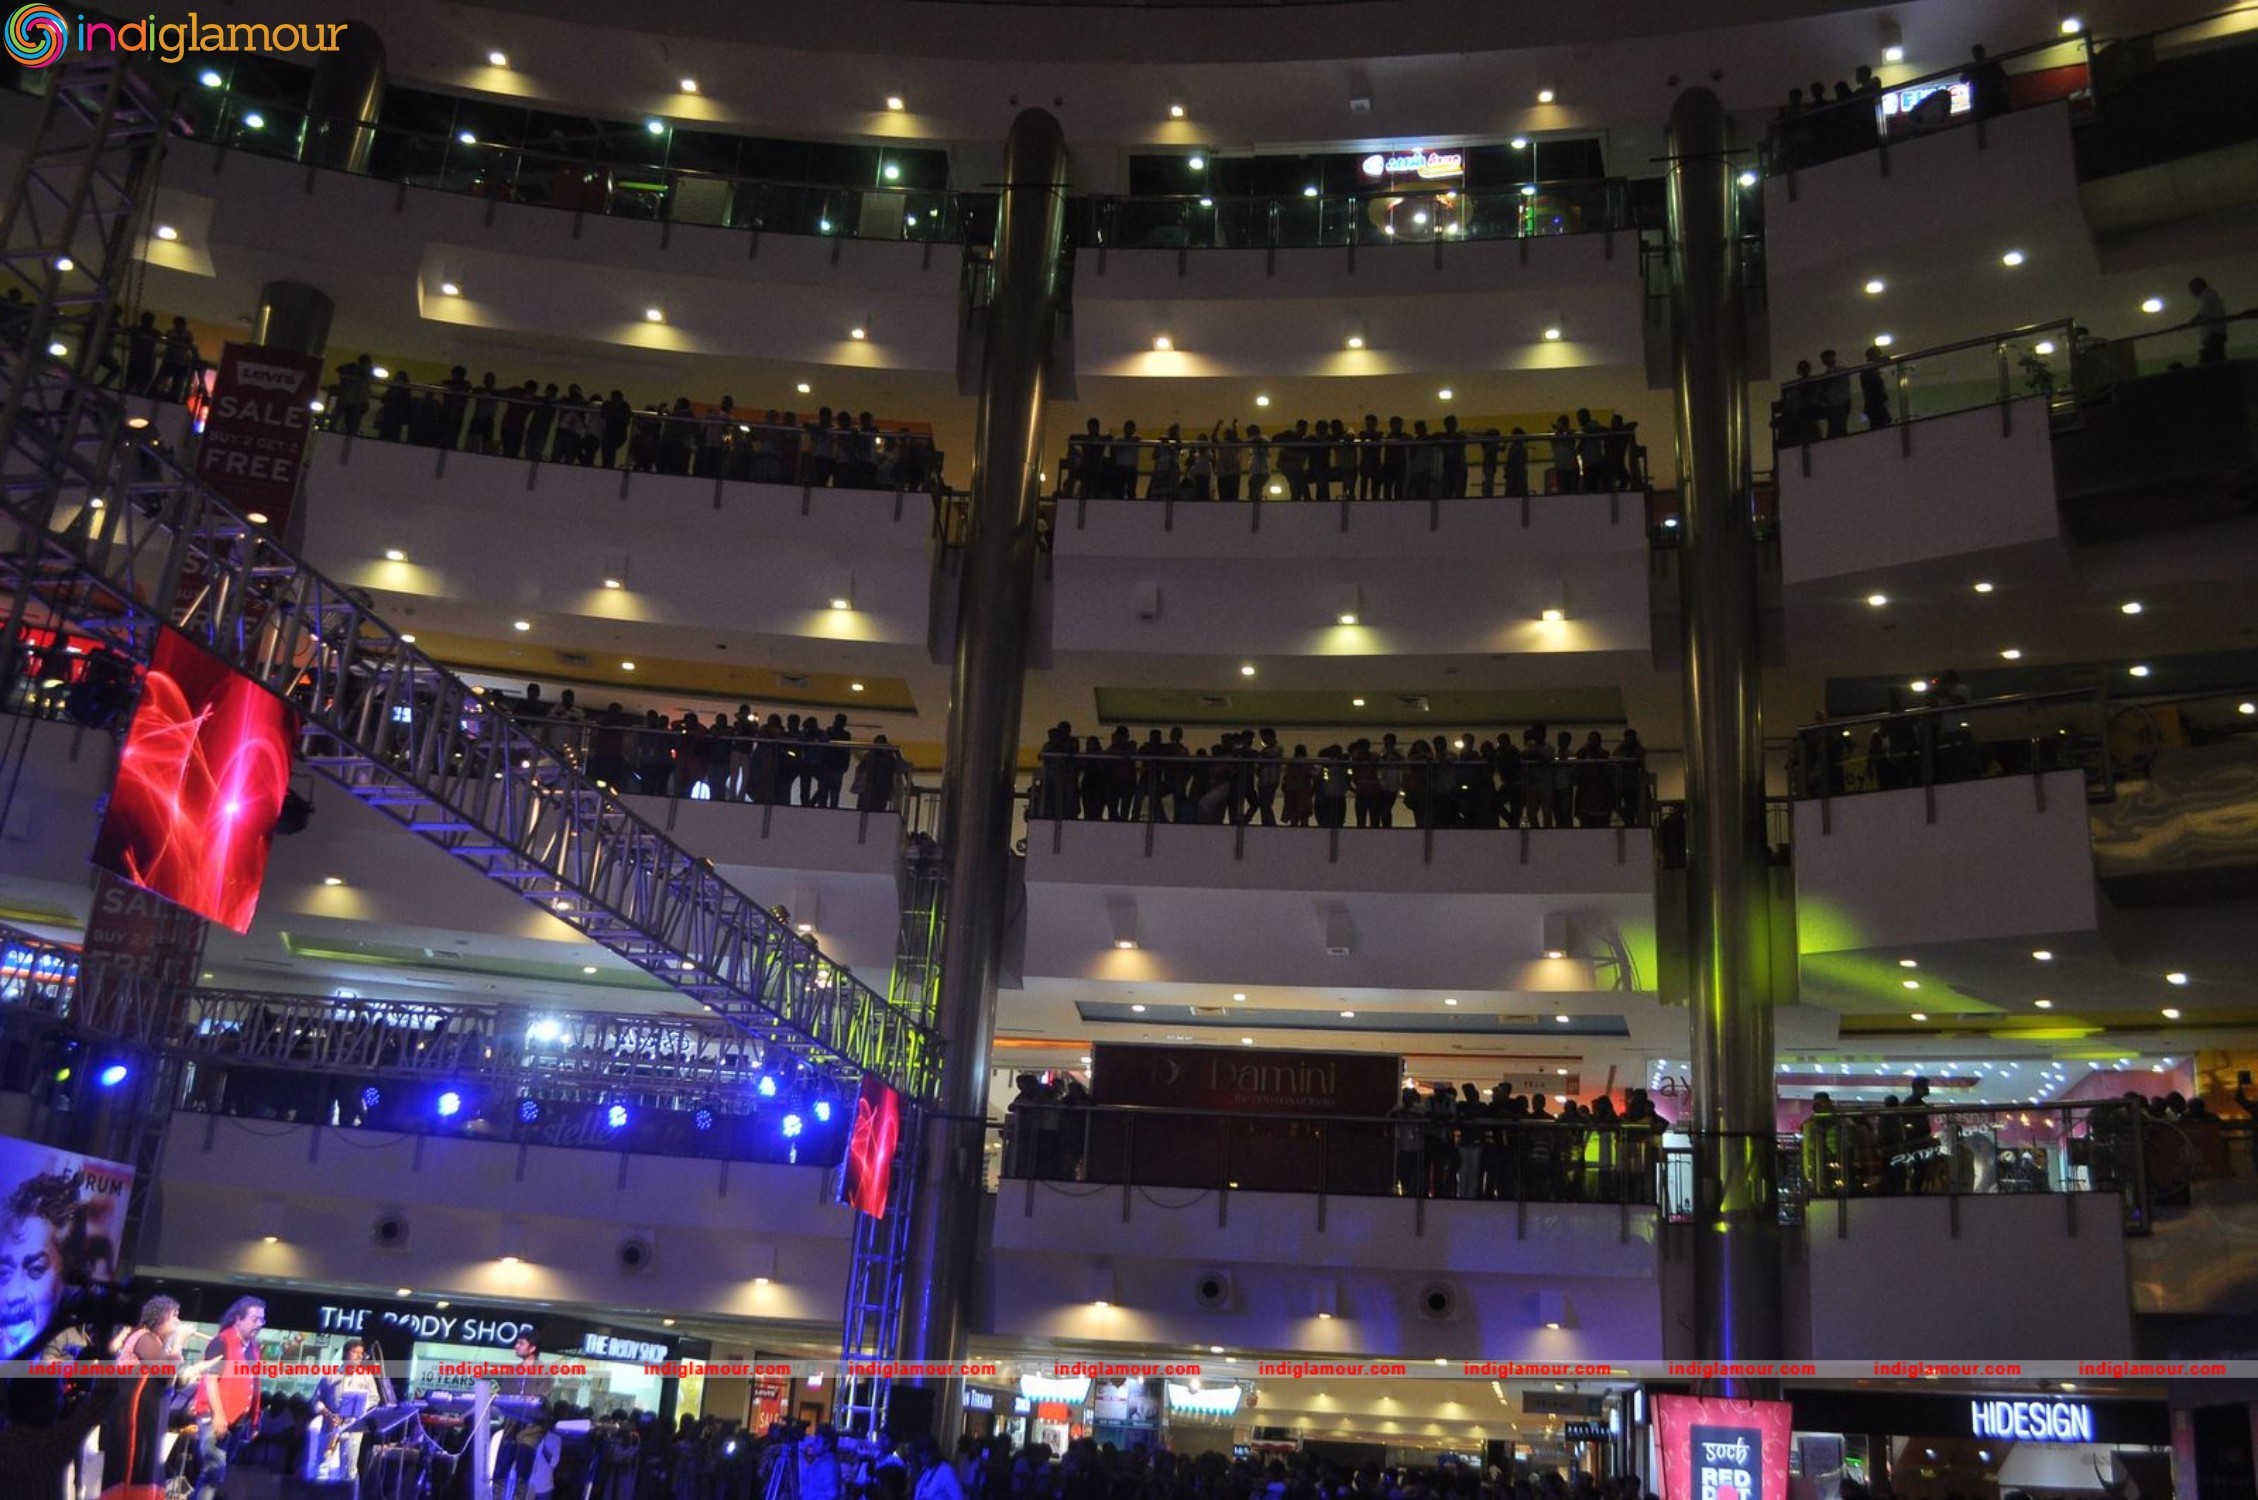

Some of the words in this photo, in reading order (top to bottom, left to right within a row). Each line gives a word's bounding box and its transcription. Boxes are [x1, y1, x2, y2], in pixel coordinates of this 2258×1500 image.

[217, 395, 305, 429] SALE
[208, 430, 240, 444] BUY
[256, 437, 286, 451] GET
[203, 447, 295, 483] FREE
[1210, 1056, 1336, 1095] Damini
[320, 1306, 373, 1331] THE
[586, 1333, 609, 1355] THE
[1971, 1400, 2091, 1441] HIDESIGN
[1701, 1467, 1752, 1487] RED
